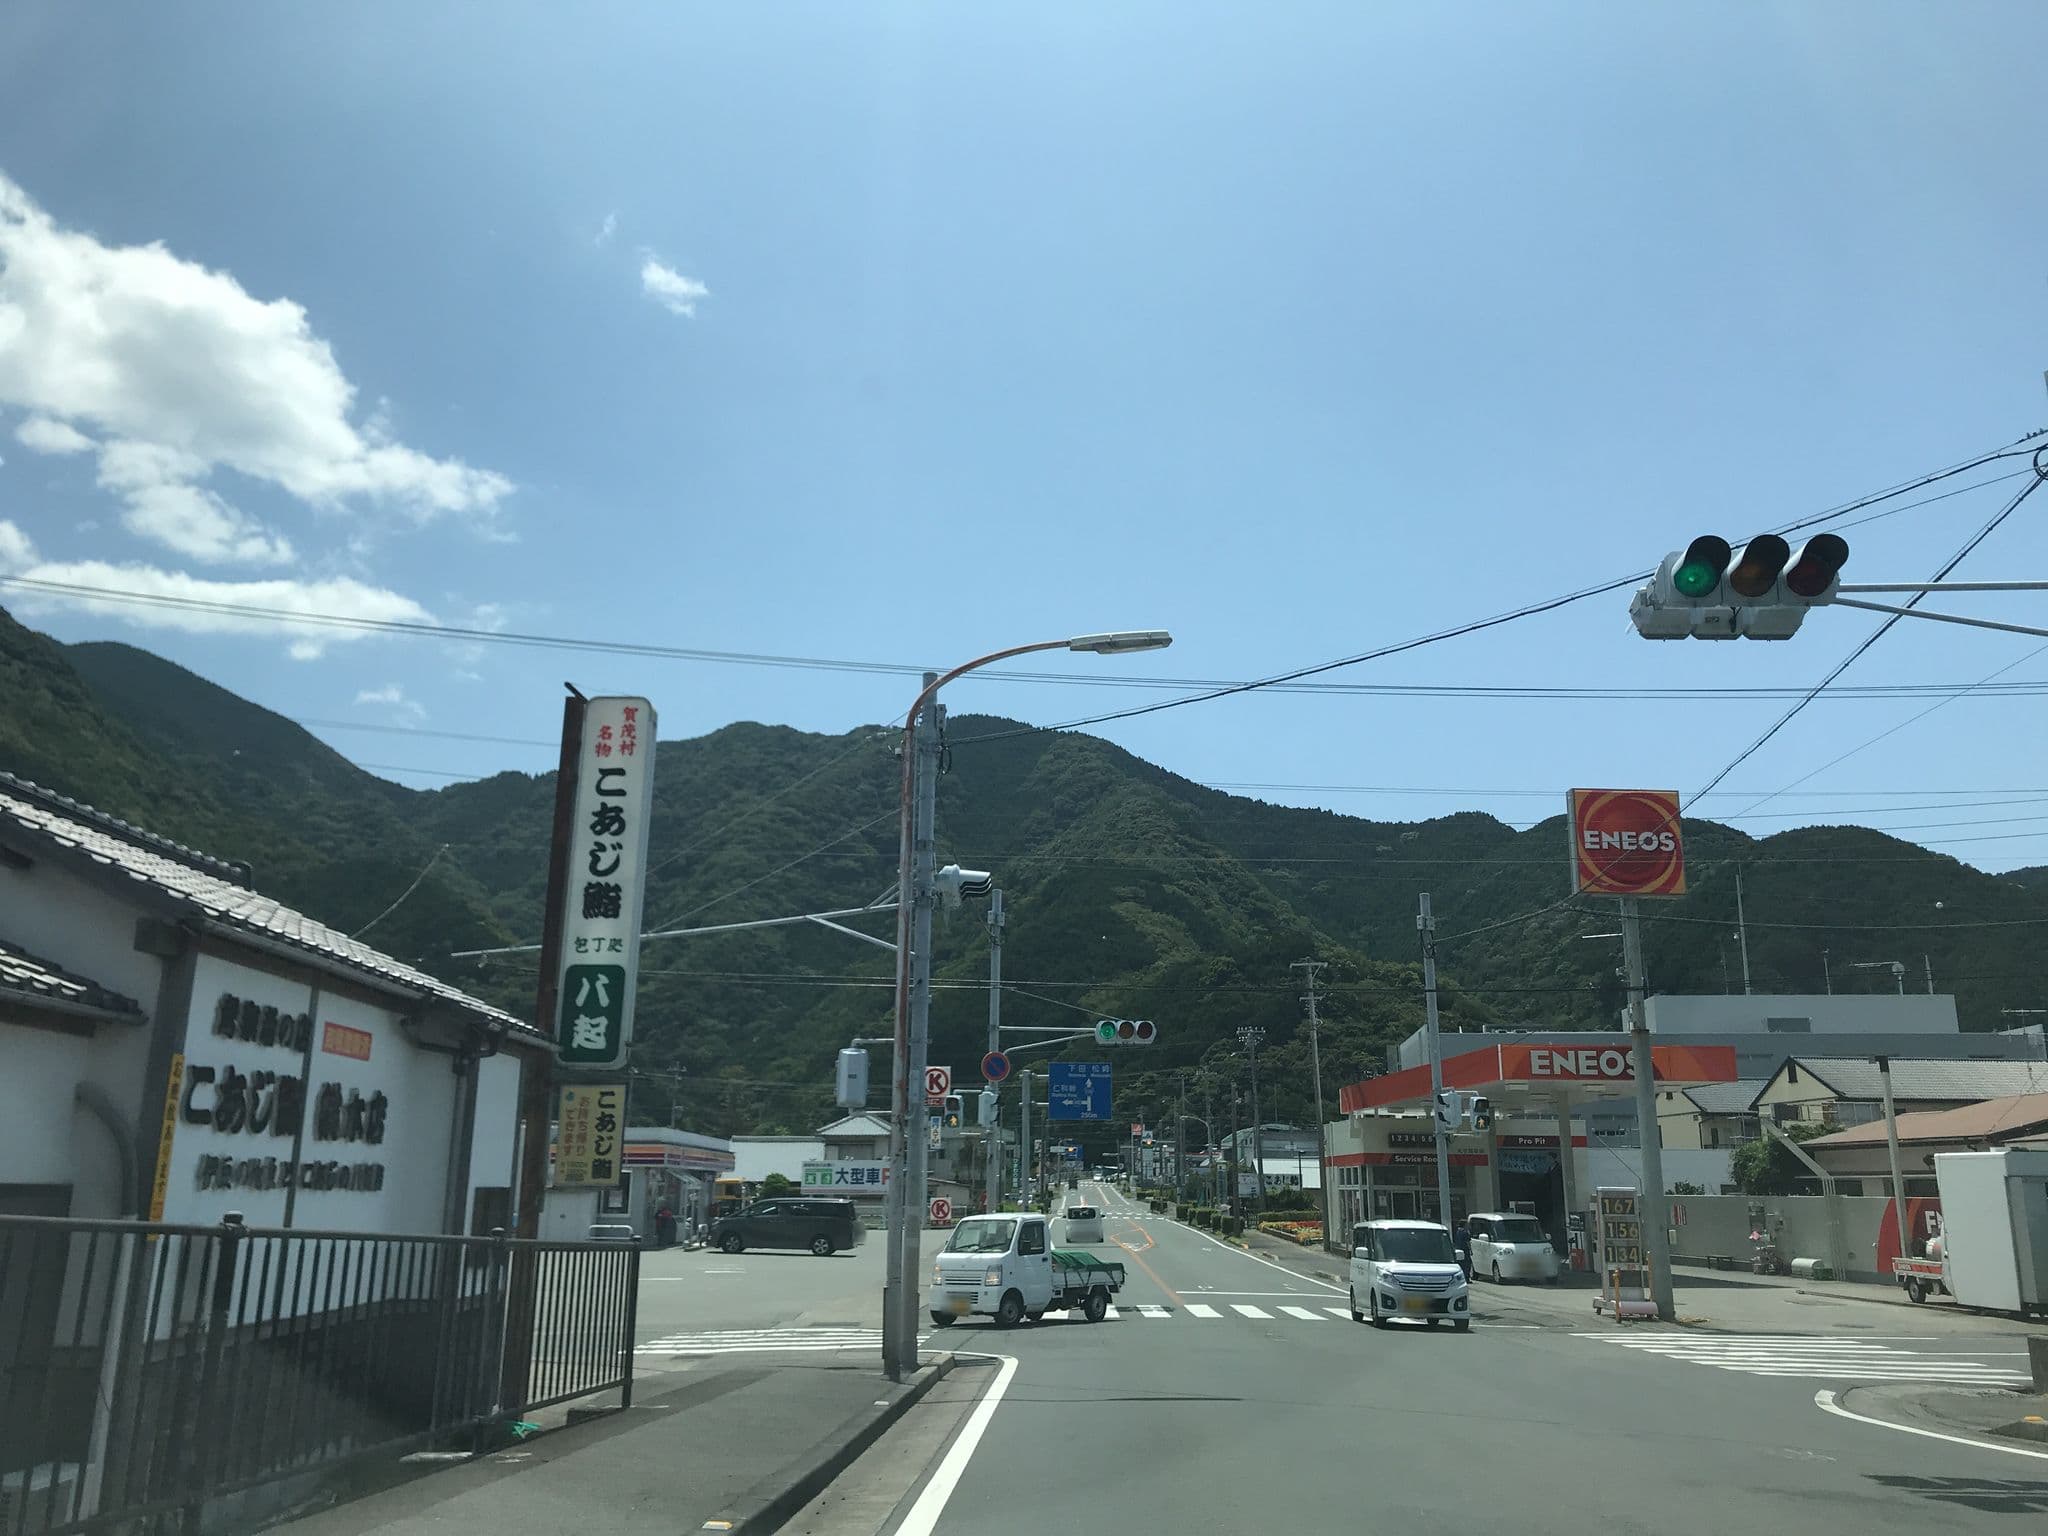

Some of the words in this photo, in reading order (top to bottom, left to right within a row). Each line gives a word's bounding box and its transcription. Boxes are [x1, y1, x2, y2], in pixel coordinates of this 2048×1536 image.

[618, 706, 639, 757] 賀茂村
[595, 725, 613, 758] 名物
[582, 767, 627, 919] こあじ鮨
[1584, 830, 1675, 852] ENEOS
[1518, 1137, 1532, 1145] Pro
[1604, 1199, 1633, 1214] 167
[1607, 1223, 1638, 1238] 156
[1607, 1247, 1638, 1262] 134
